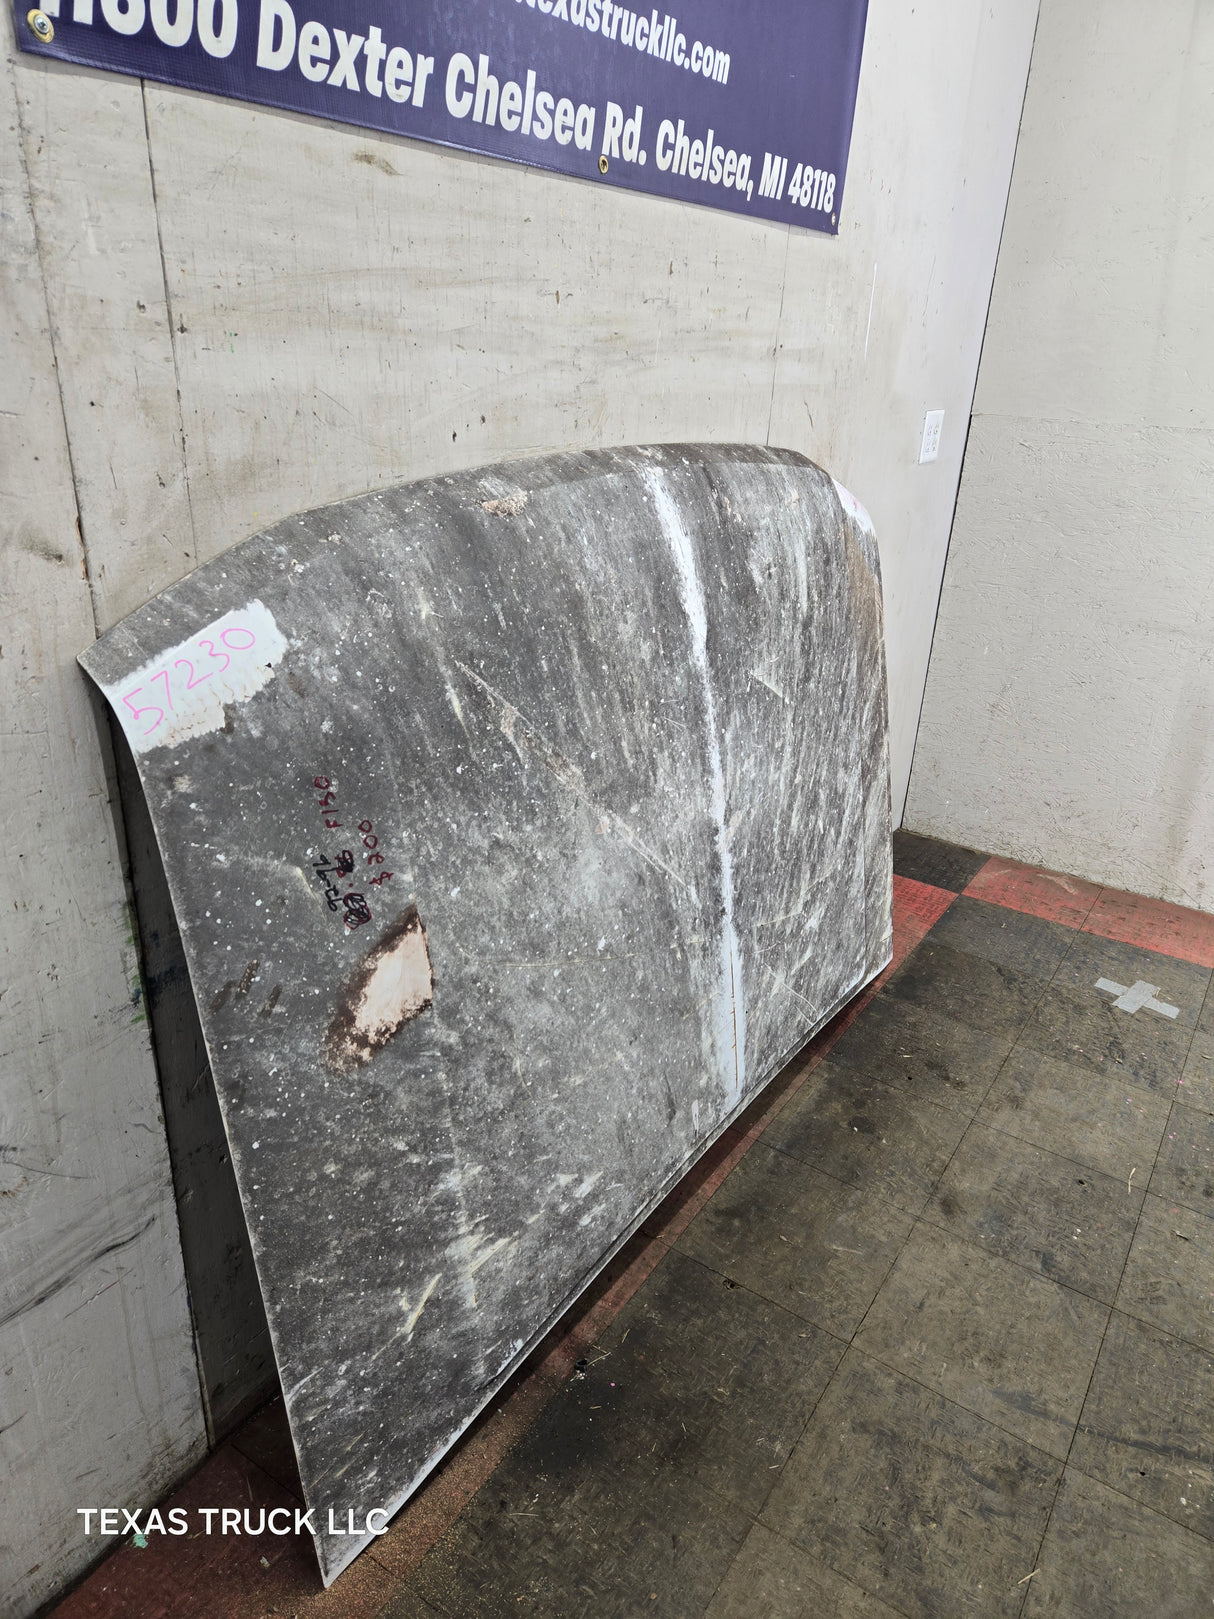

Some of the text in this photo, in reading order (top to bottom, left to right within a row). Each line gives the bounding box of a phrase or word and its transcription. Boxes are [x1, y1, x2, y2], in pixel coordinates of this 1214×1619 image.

[256, 0, 434, 108] Dexter
[445, 53, 595, 151] Chelsea
[601, 101, 647, 166] Rd.
[655, 119, 754, 202] Chelsea,
[758, 152, 788, 200] MI
[788, 163, 836, 213] 48118
[122, 627, 256, 736] 57230
[314, 776, 344, 829] F150
